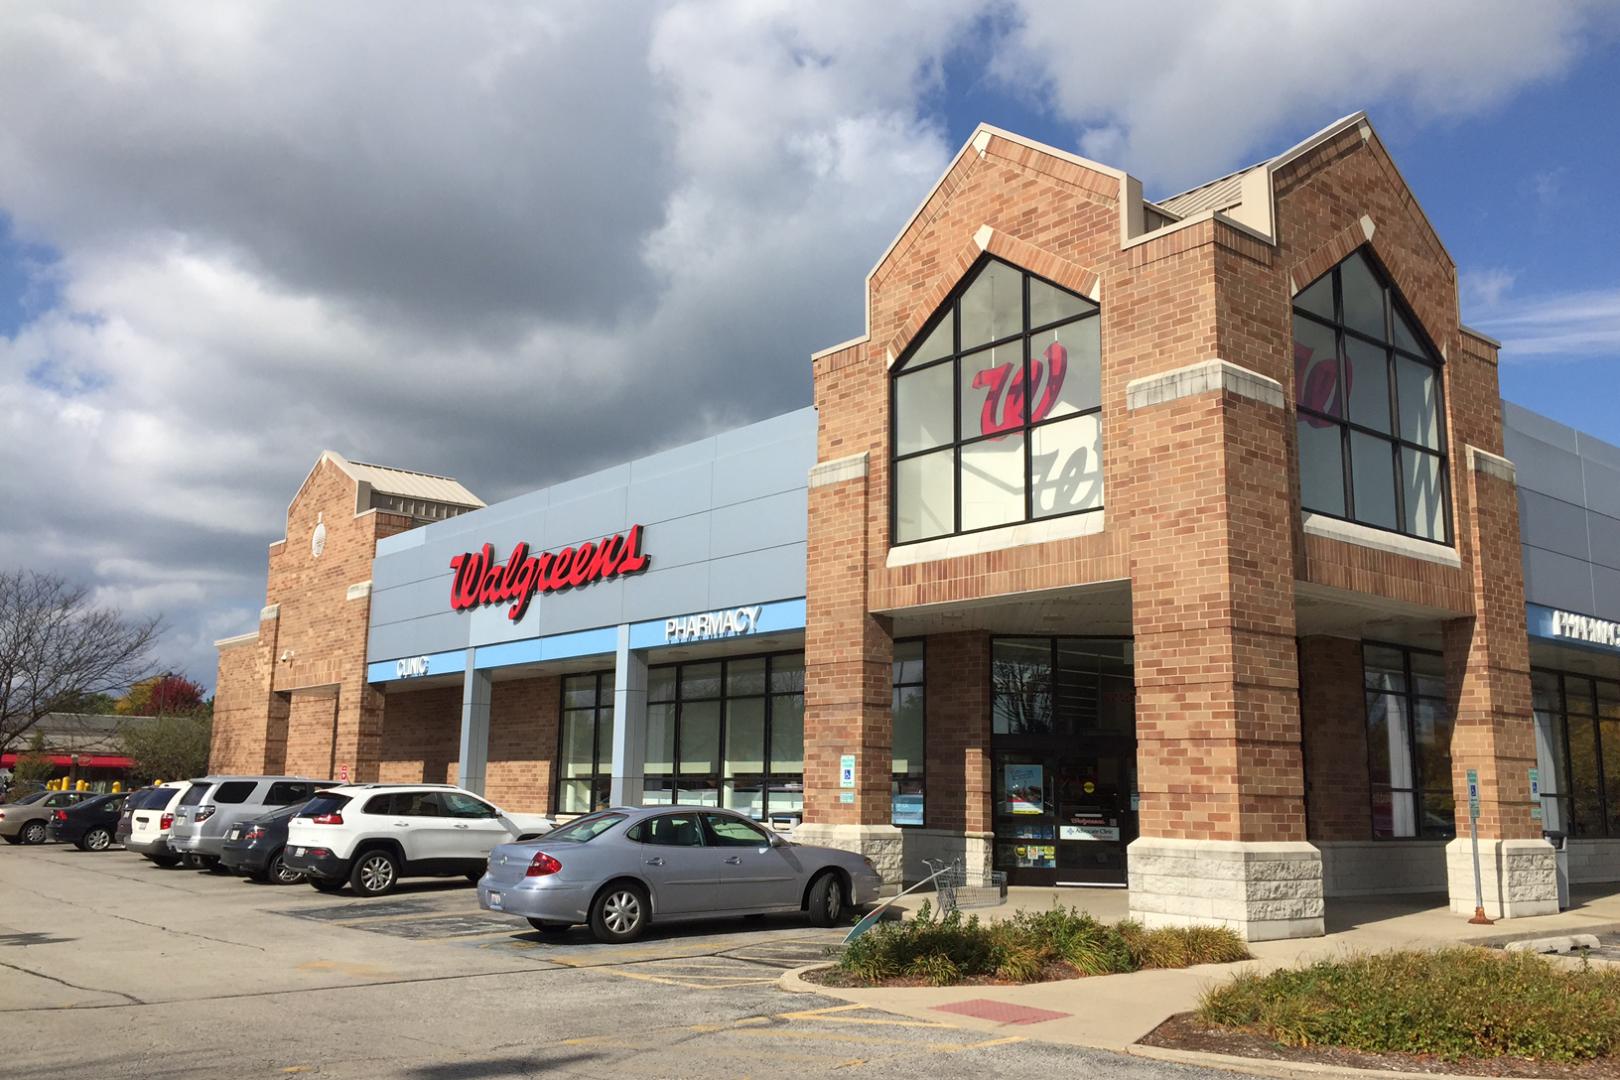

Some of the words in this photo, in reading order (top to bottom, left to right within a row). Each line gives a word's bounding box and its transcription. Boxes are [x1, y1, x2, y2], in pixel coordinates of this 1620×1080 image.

[972, 341, 1068, 442] W
[450, 524, 650, 621] Walgreens
[665, 606, 762, 641] PHARMACY
[397, 656, 430, 677] CLINIC
